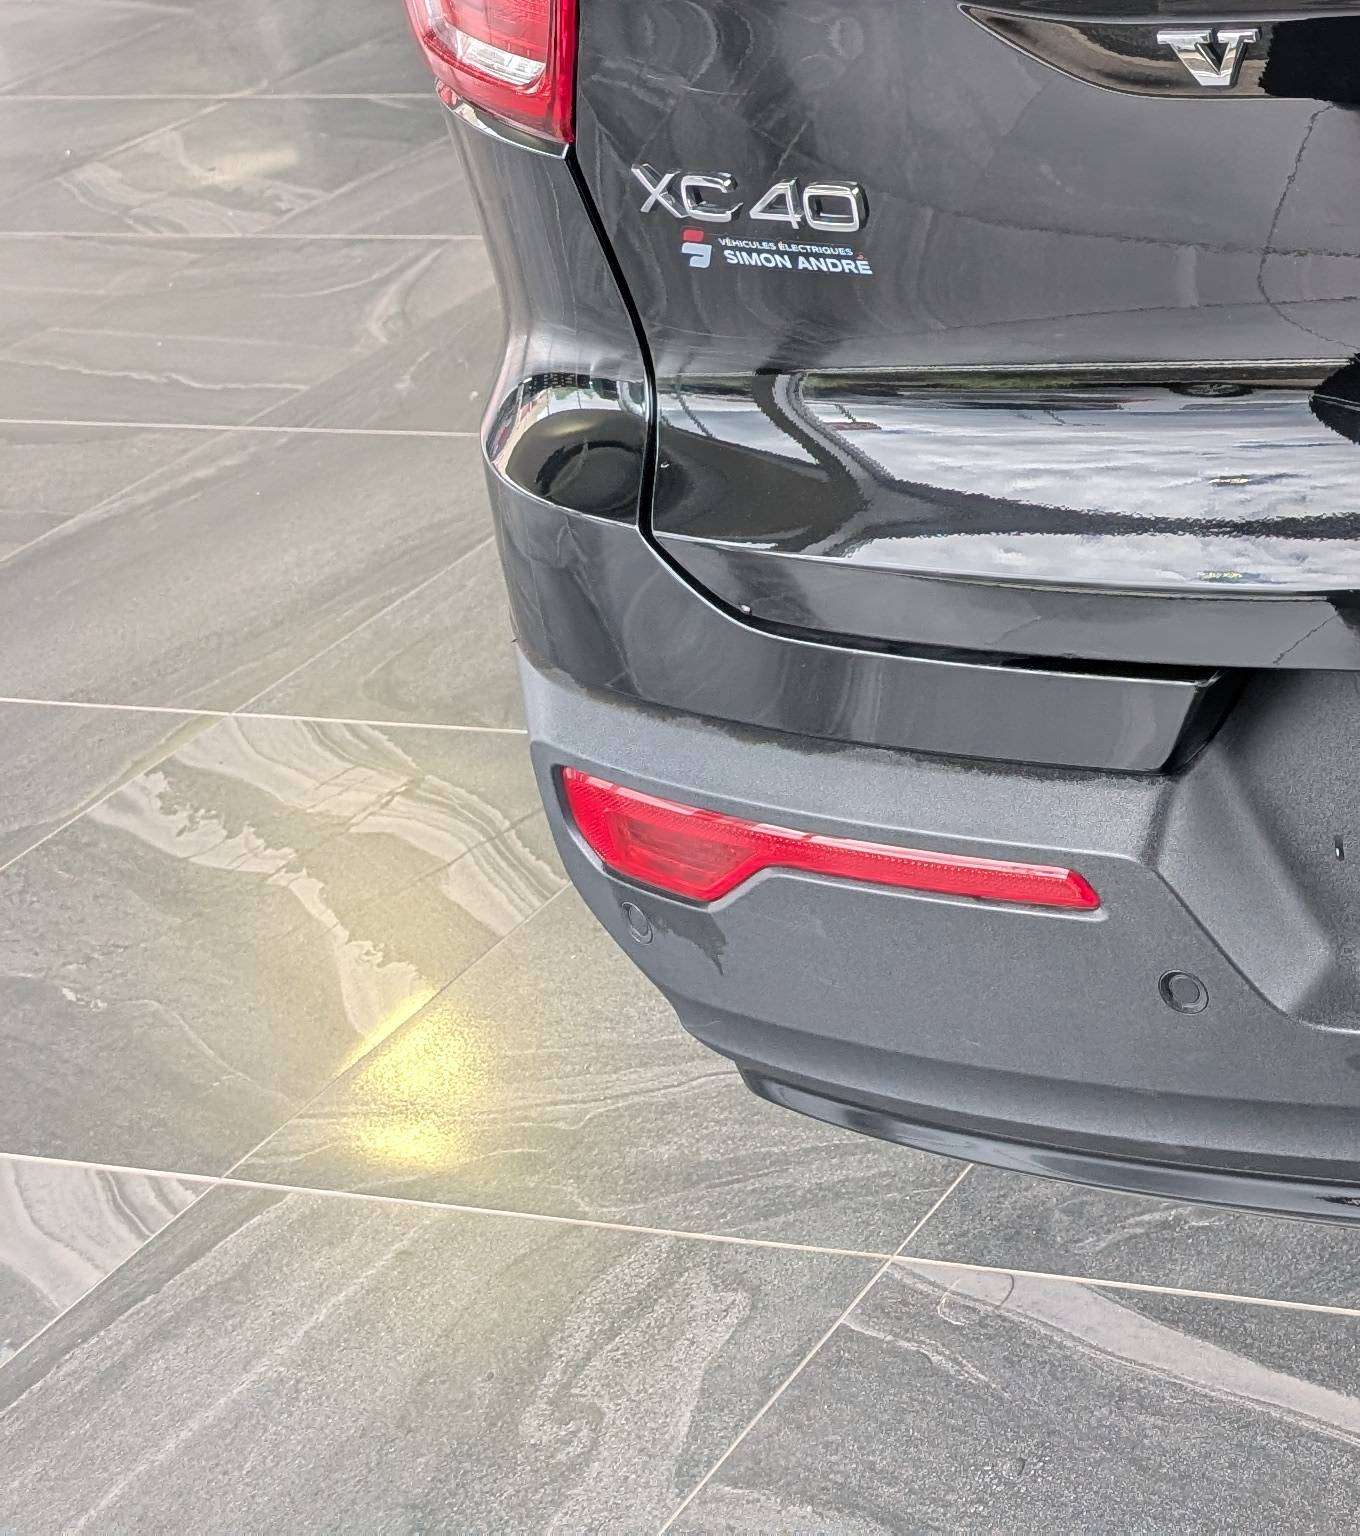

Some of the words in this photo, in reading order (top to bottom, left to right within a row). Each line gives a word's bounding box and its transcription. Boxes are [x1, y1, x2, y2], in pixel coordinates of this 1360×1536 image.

[717, 237, 776, 251] VÉHICULES
[778, 240, 854, 256] ÉLECTRIQUES
[723, 249, 793, 269] SIMON
[798, 252, 873, 275] ANDRÉ
